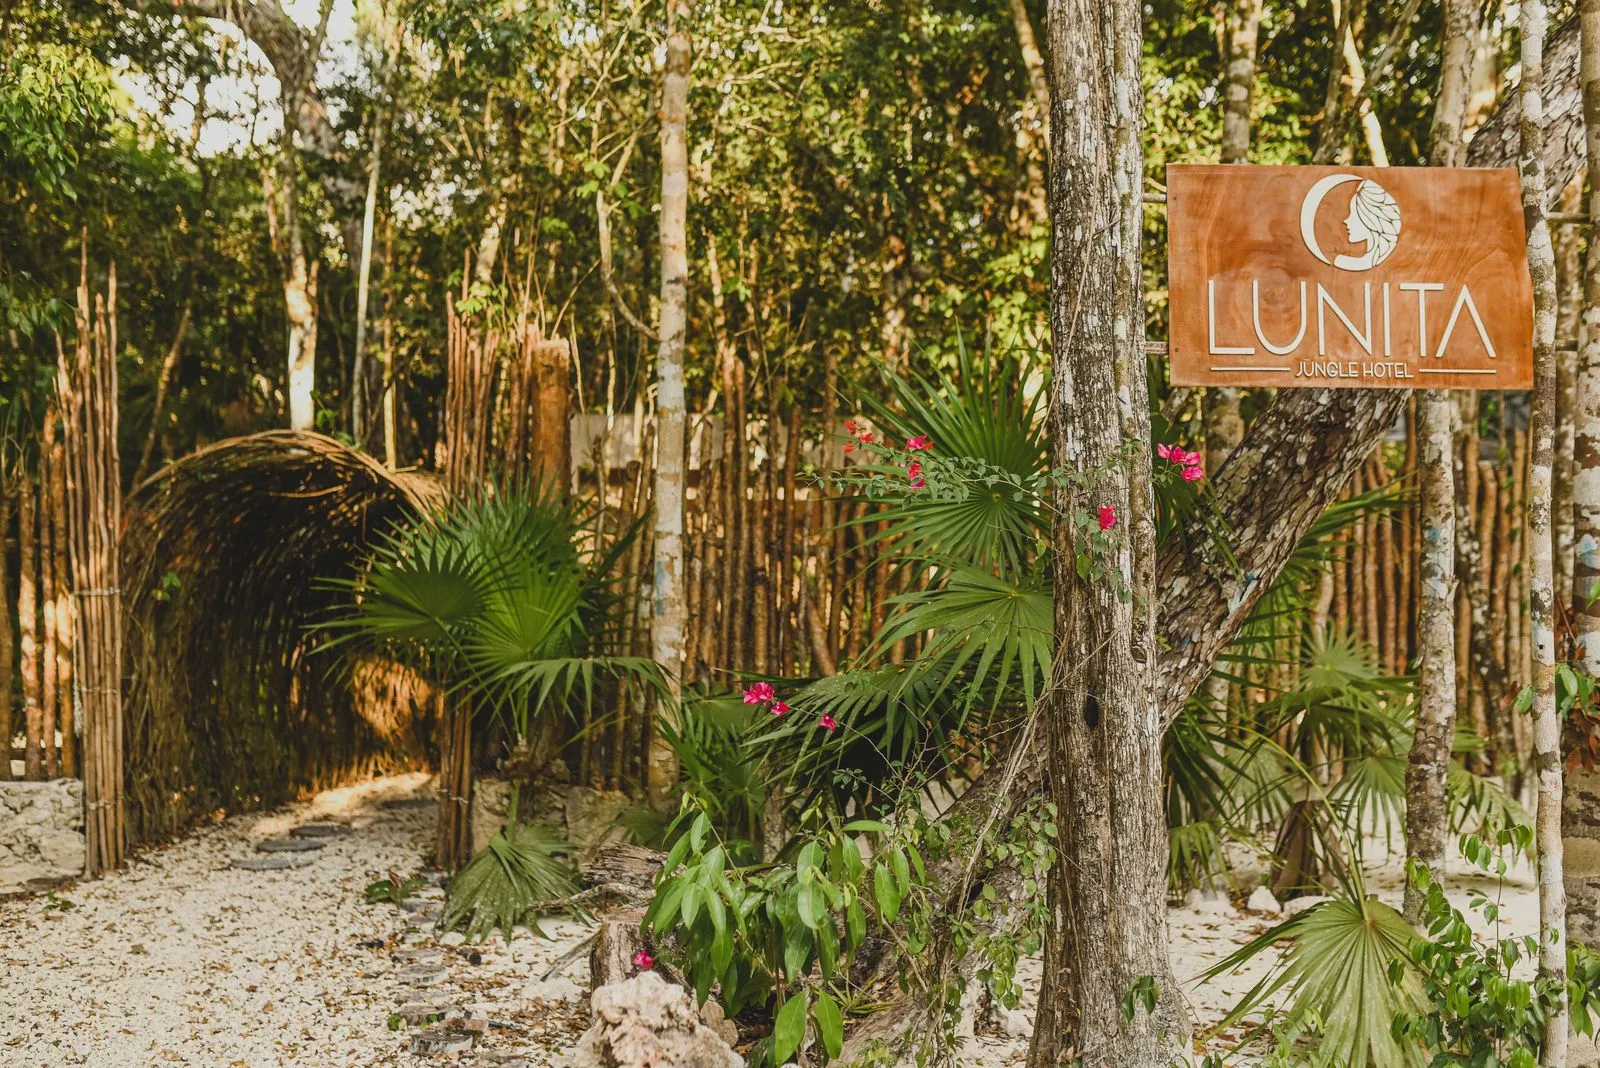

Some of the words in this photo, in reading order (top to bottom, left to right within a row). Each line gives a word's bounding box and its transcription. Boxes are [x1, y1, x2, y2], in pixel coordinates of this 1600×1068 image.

[1208, 280, 1496, 358] LUNITA
[1296, 361, 1359, 378] JUNGLE
[1363, 361, 1414, 378] HOTEL
